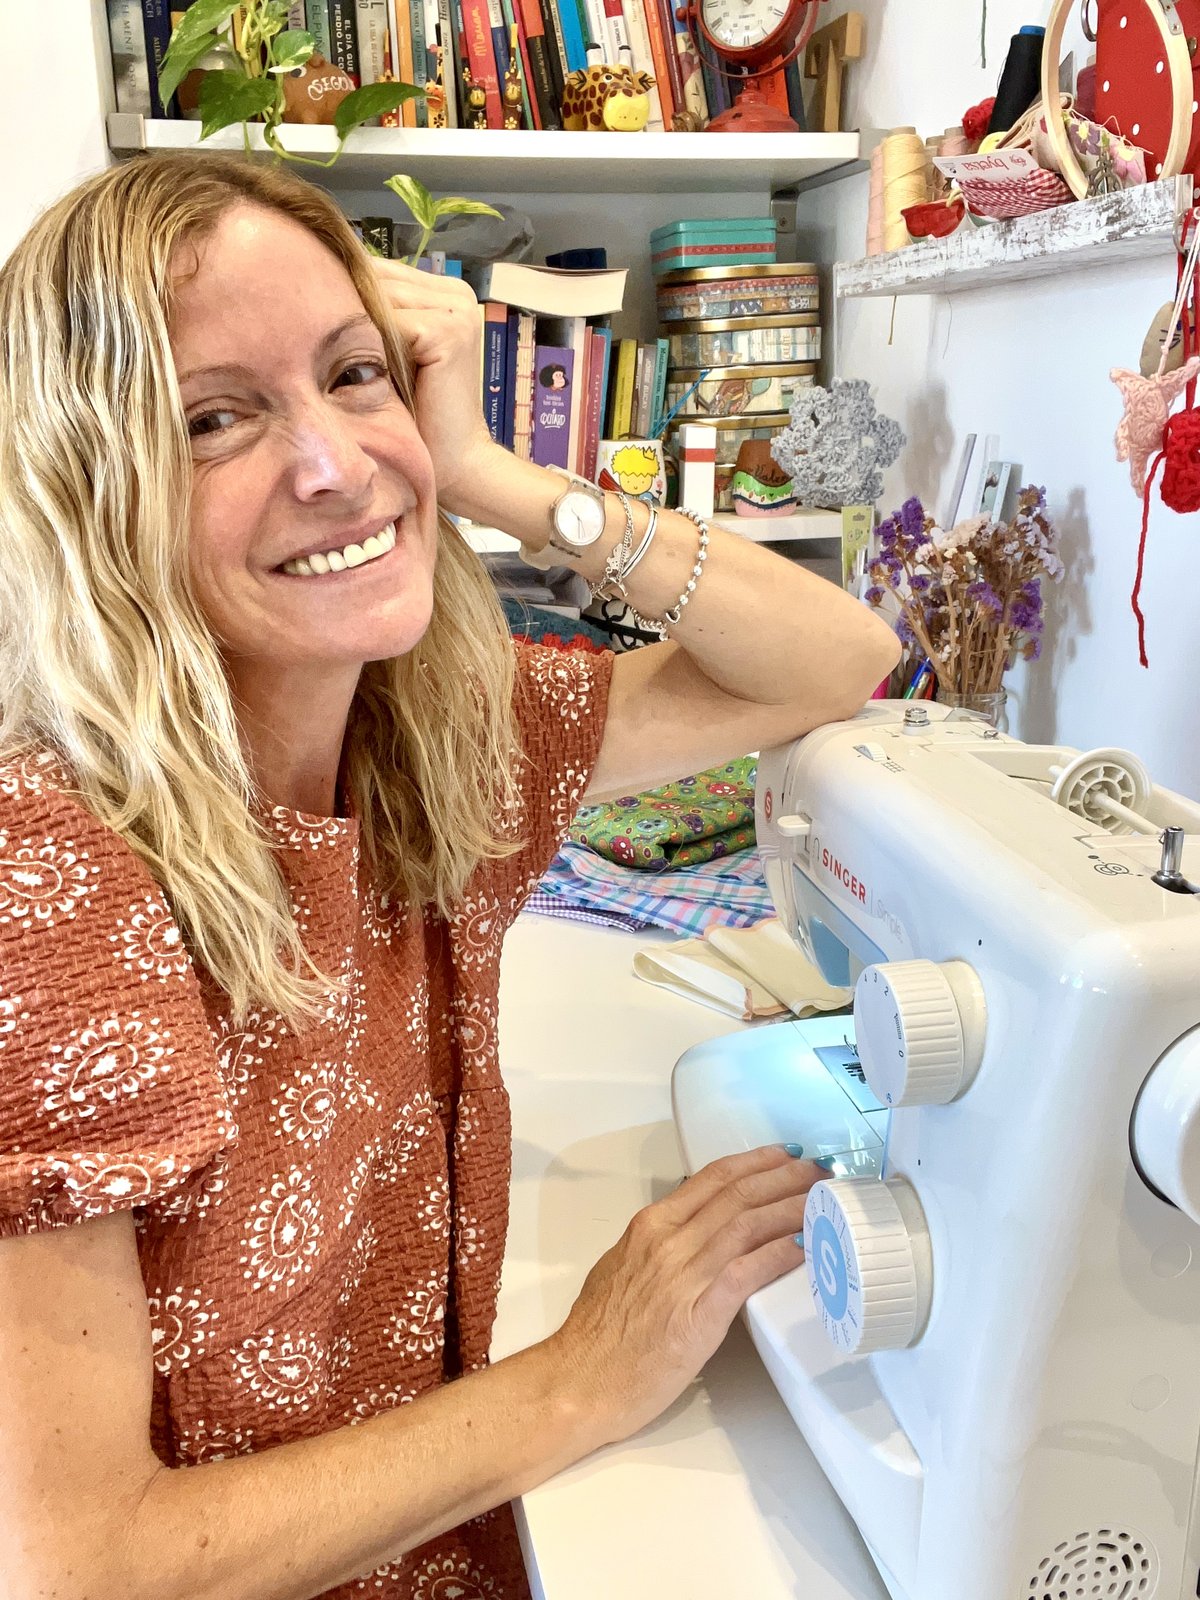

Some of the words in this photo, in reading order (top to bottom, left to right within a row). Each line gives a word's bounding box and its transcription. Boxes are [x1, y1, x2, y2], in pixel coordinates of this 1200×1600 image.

[334, 3, 343, 38] PERDIÓ
[344, 19, 351, 31] EL
[337, 41, 343, 53] LA
[346, 53, 354, 72] QUE
[822, 848, 867, 905] SINGER
